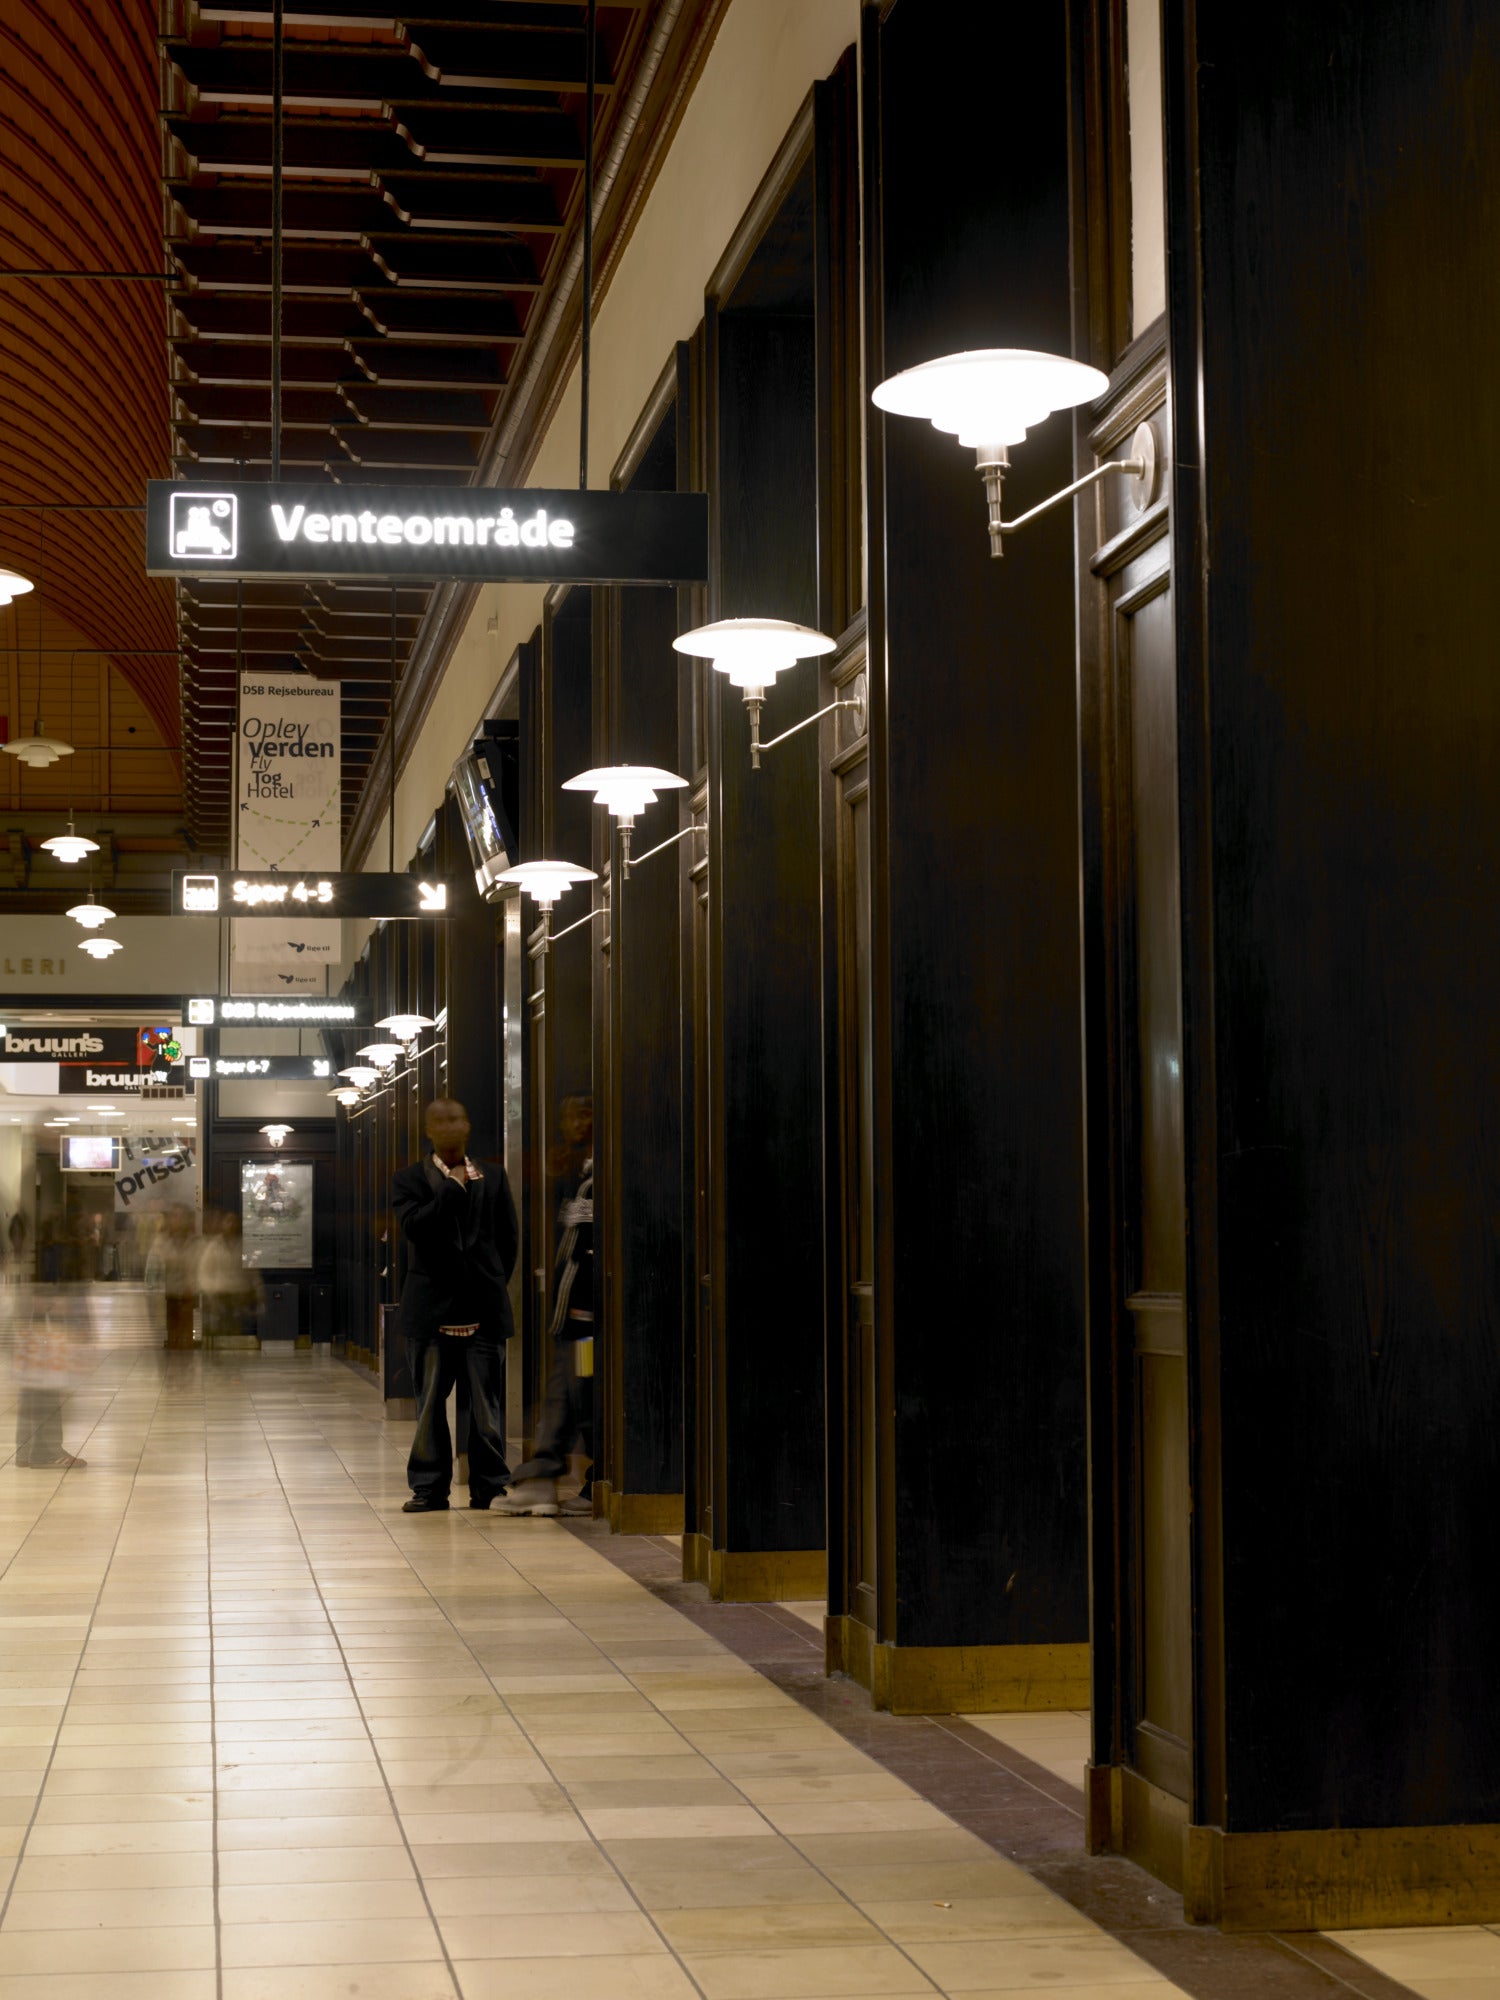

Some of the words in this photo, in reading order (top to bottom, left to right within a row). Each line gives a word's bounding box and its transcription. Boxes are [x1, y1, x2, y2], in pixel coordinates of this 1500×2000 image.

[271, 504, 576, 549] Venteområde
[242, 685, 265, 696] DSB
[268, 686, 334, 697] Rejsebureau
[242, 717, 310, 744] Oplev
[248, 739, 335, 758] verden
[250, 756, 272, 773] Fly
[252, 770, 282, 787] Tog
[247, 782, 294, 799] Hotel
[232, 880, 289, 906] Spor
[292, 881, 334, 903] 4-5
[5, 1033, 104, 1053] bruun's
[115, 1147, 192, 1206] priser
